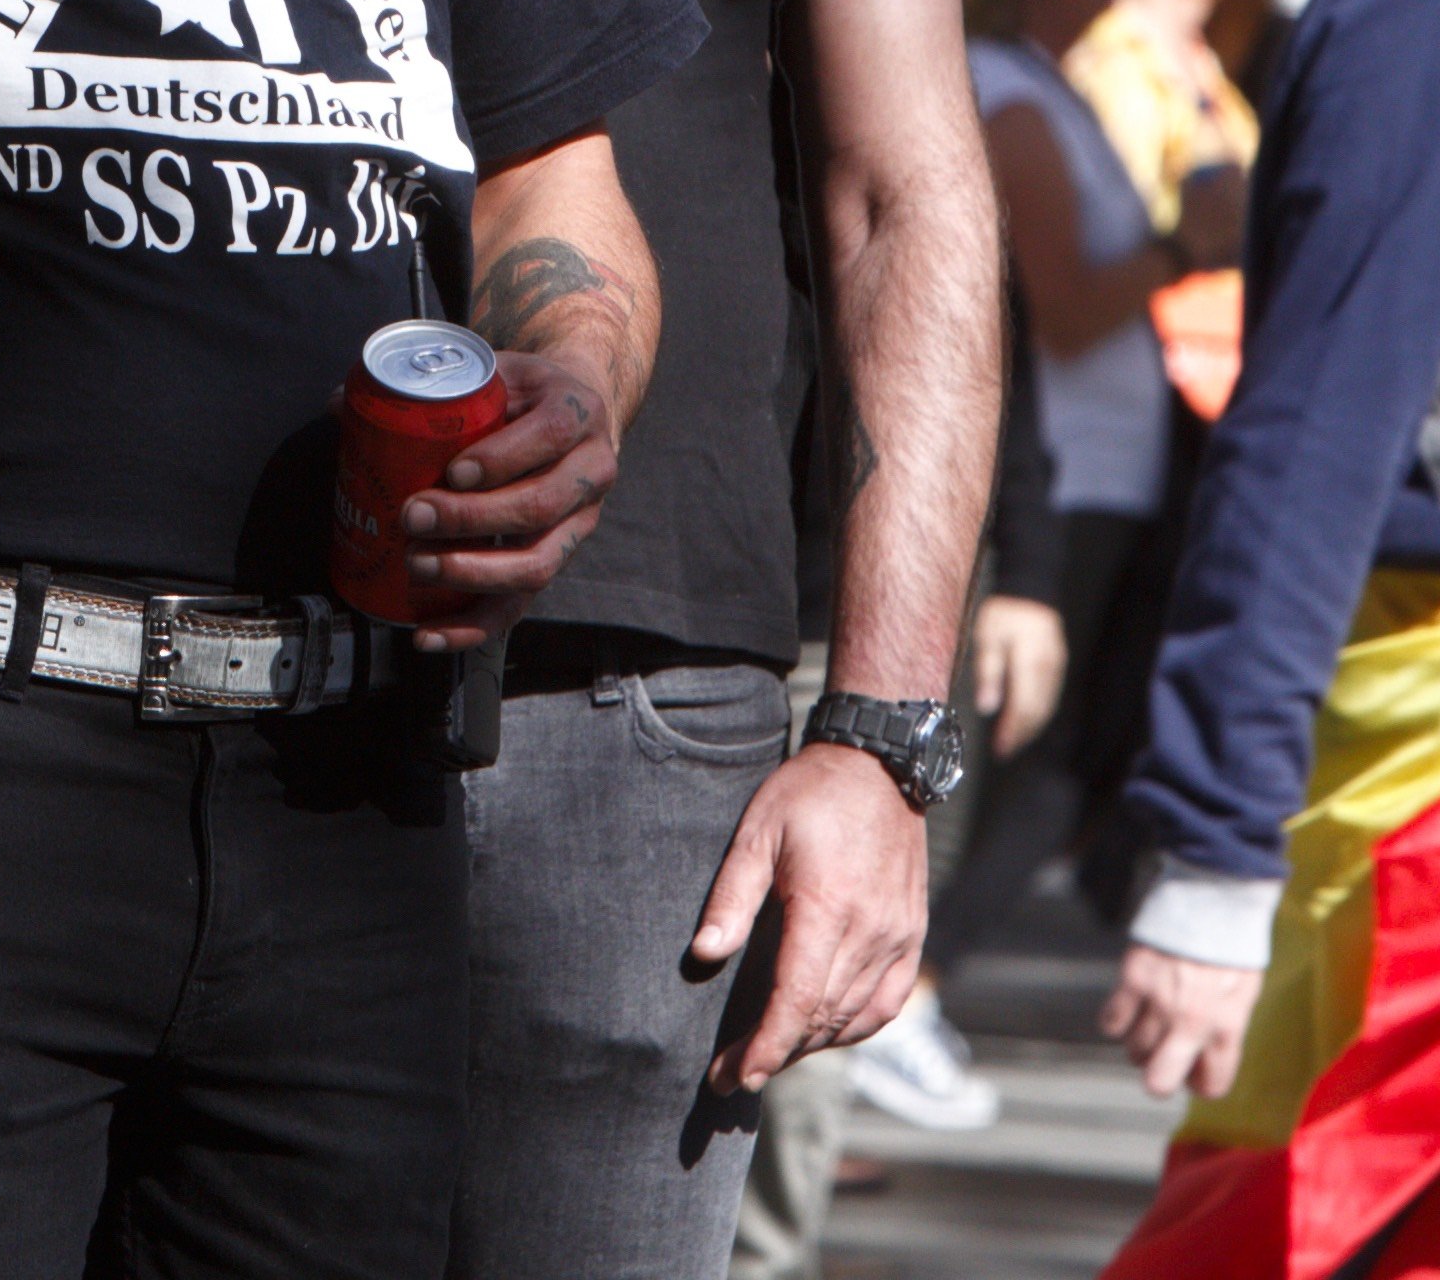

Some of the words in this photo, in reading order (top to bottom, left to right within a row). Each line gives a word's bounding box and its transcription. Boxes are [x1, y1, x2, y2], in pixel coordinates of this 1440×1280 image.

[26, 65, 406, 143] Deutschland
[83, 146, 195, 255] SS
[211, 158, 337, 257] Pz.
